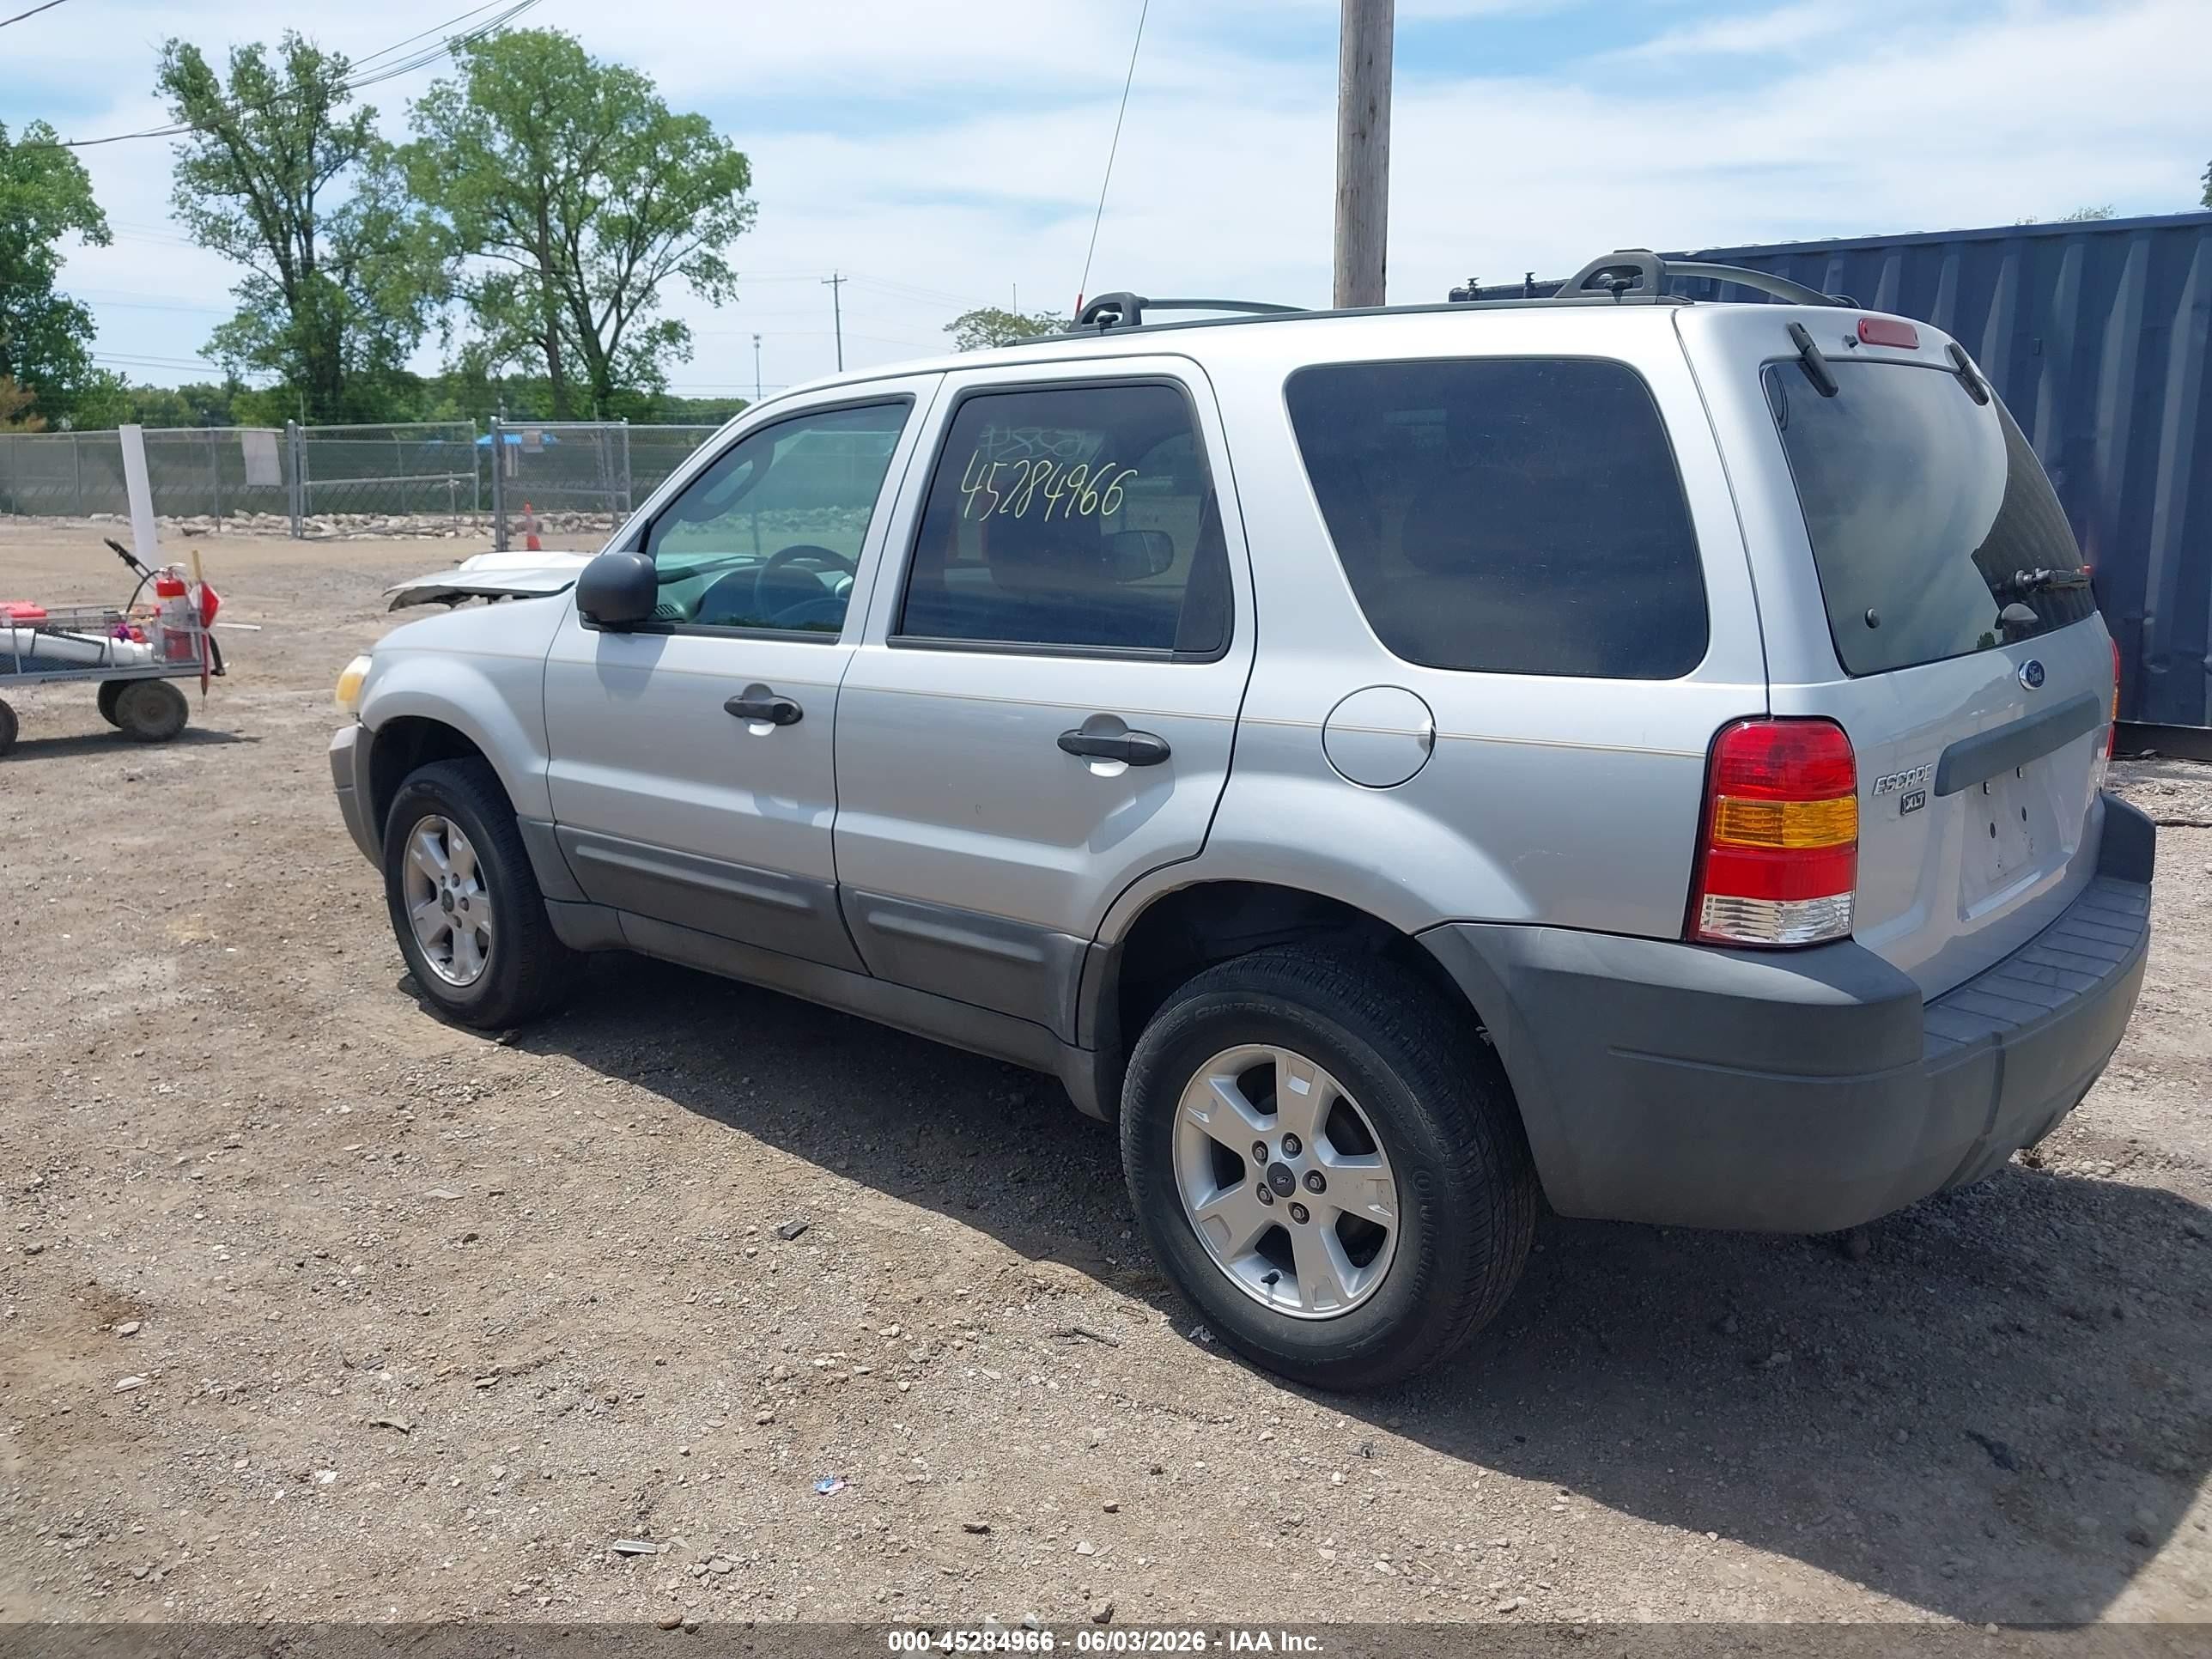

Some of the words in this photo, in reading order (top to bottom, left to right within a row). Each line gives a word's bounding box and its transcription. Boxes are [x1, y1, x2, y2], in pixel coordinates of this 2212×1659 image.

[960, 449, 1139, 523] 45284966
[1872, 763, 1933, 797] ESCAPE
[1905, 793, 1924, 810] XLT
